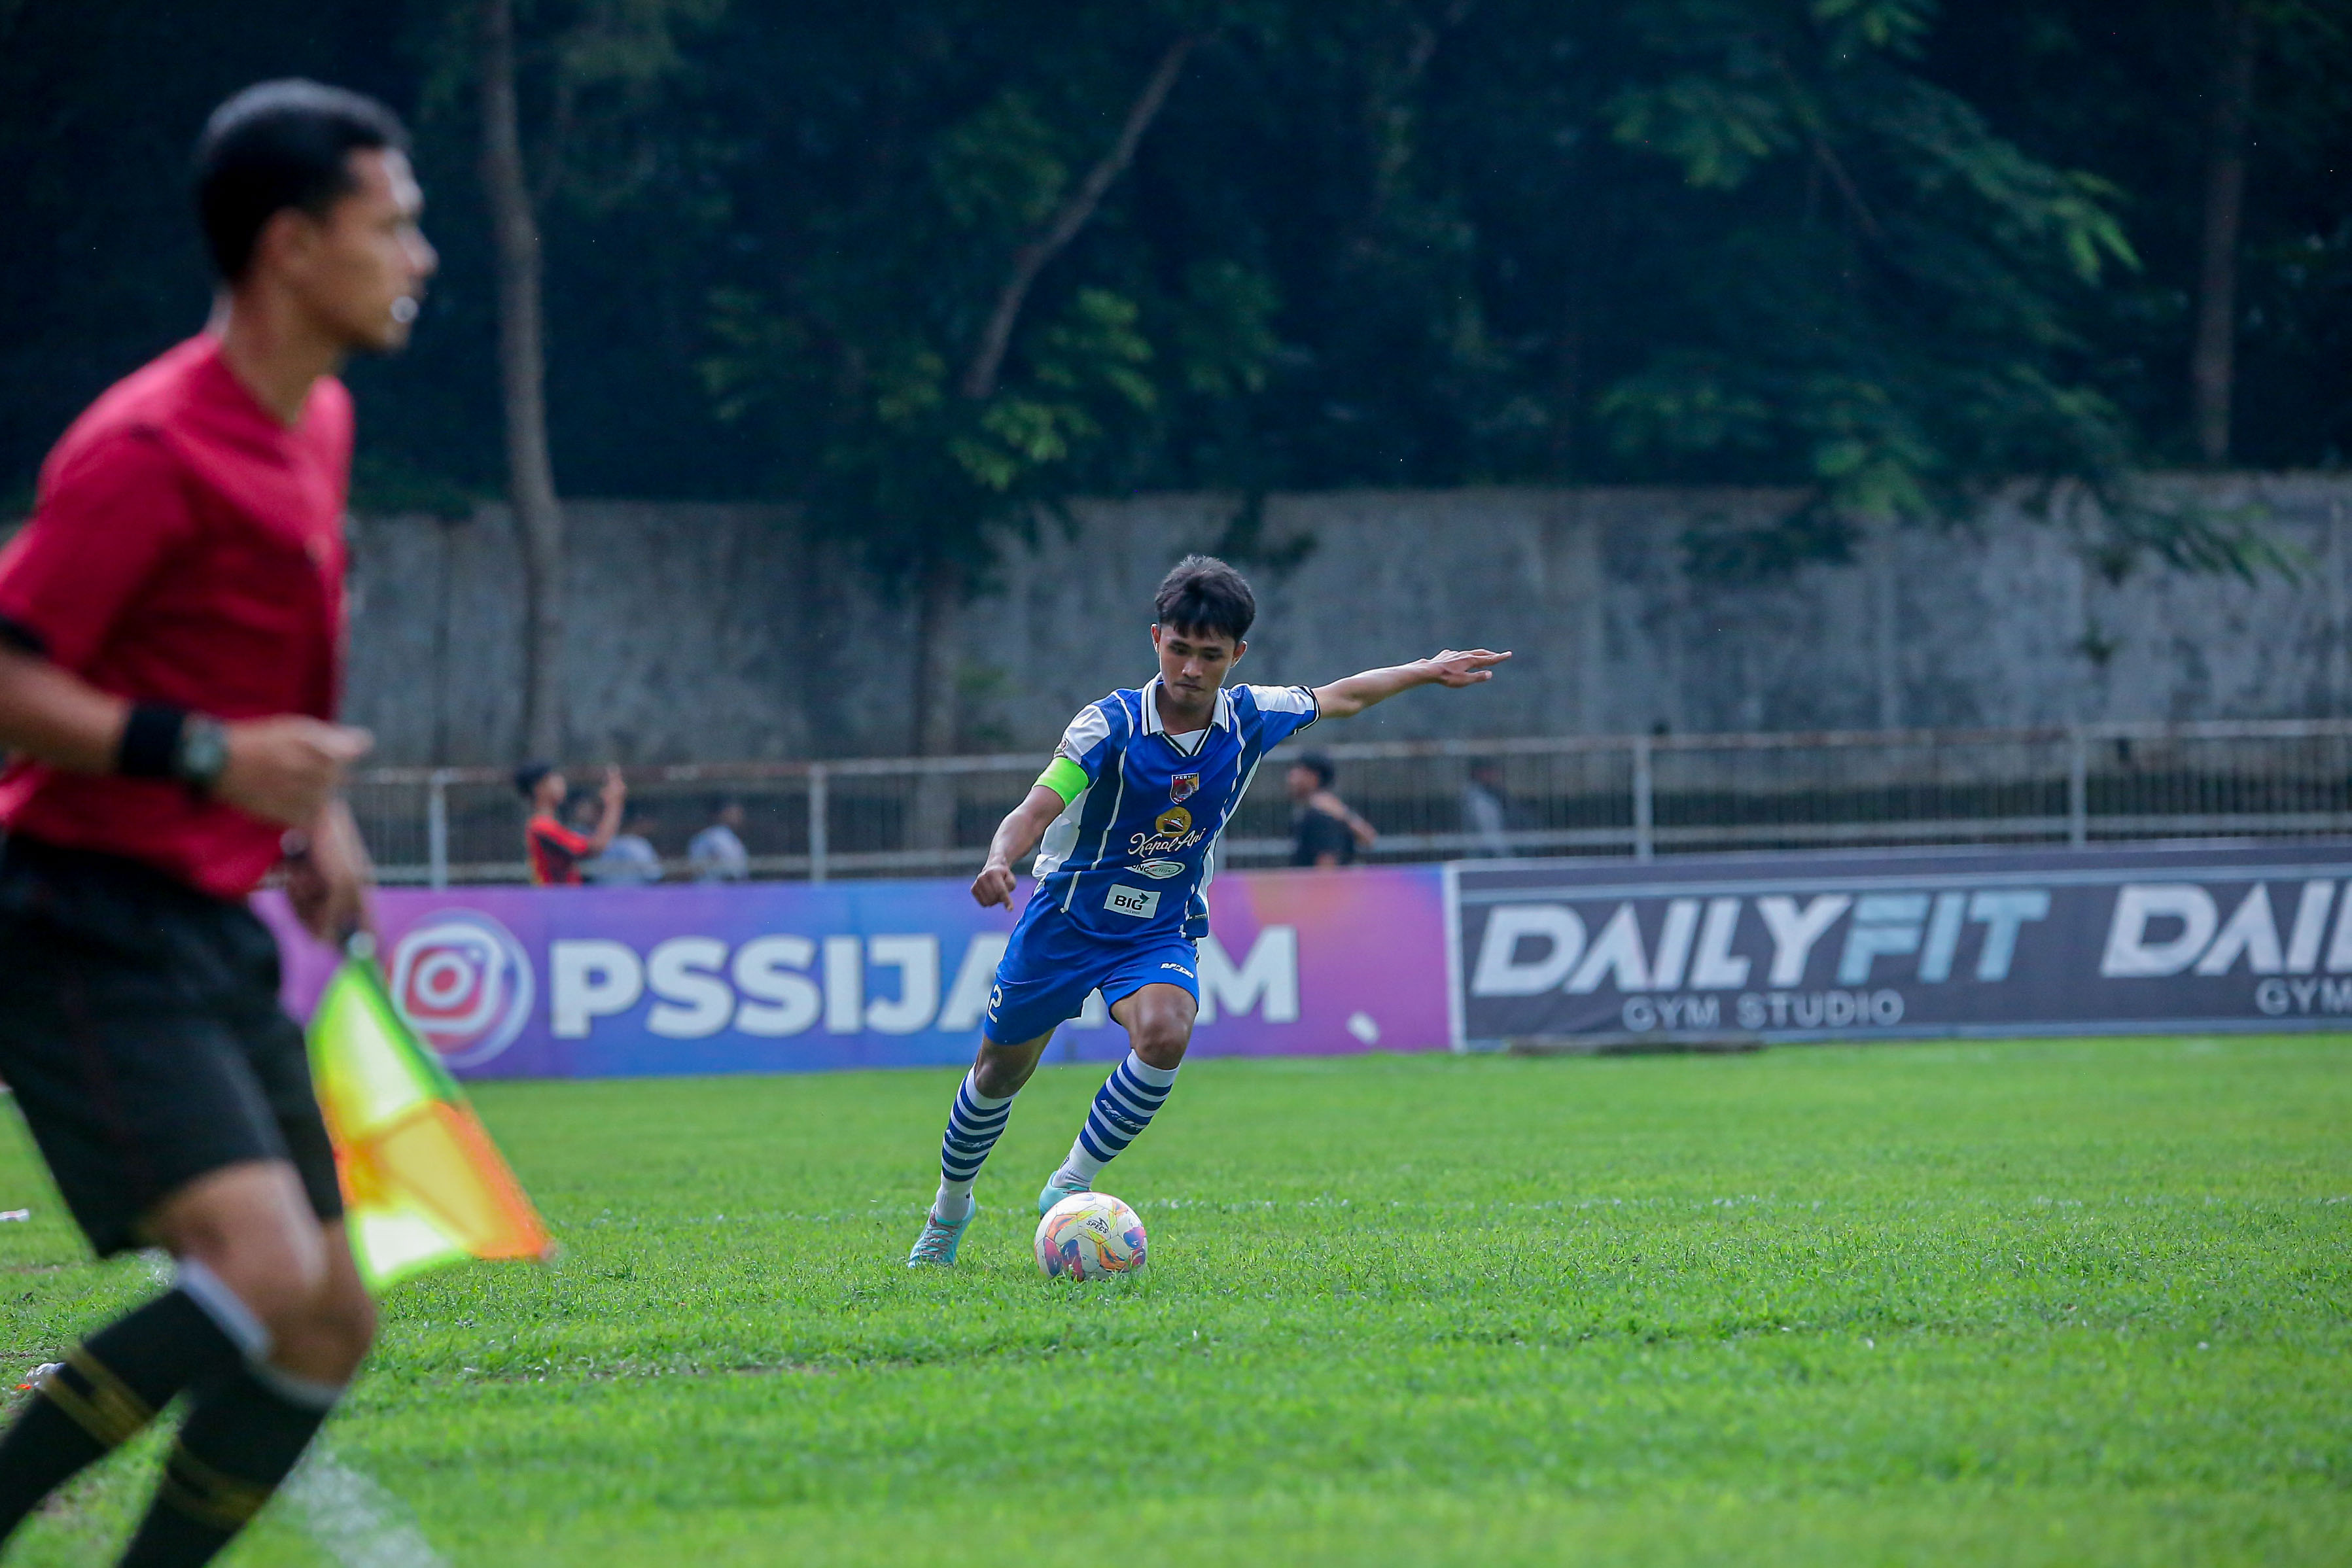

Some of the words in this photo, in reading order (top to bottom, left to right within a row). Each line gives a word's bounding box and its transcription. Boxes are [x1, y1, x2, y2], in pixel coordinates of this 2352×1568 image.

[1128, 832, 1179, 858] Kapal
[1175, 828, 1206, 852] Api
[1114, 895, 1142, 910] BIG
[988, 984, 1002, 1024] 2
[1623, 992, 1721, 1032] GYM
[1736, 988, 1904, 1030] STUDIO
[1086, 1220, 1108, 1234] SPECS
